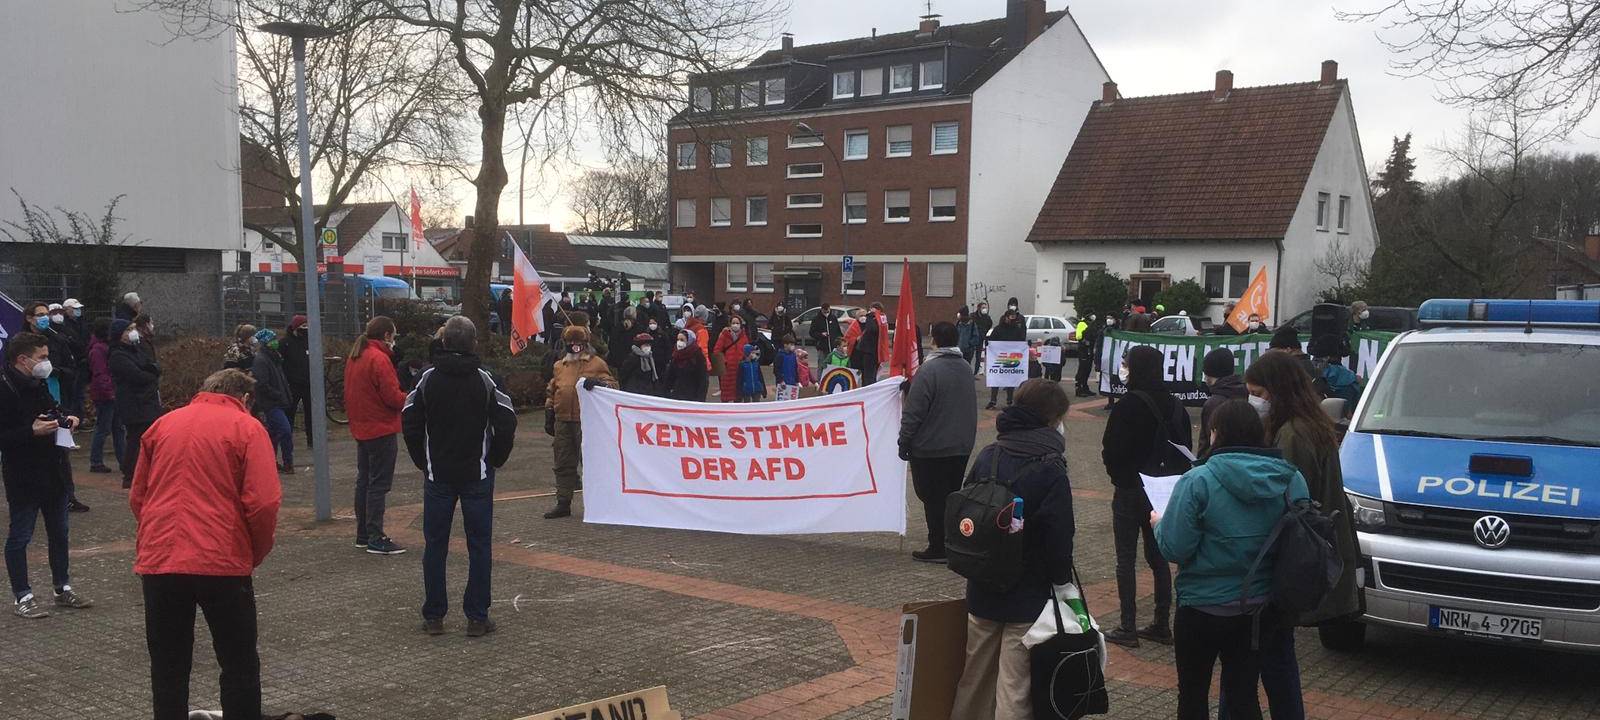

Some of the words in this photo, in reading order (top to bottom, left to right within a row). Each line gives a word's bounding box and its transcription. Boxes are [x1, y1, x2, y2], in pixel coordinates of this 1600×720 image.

[999, 367, 1024, 375] borders
[1187, 389, 1198, 400] und
[635, 422, 722, 448] KEINE
[728, 421, 848, 449] STIMME
[680, 456, 737, 481] DER
[747, 457, 806, 481] AFD
[1417, 476, 1581, 506] POLIZEI
[1440, 610, 1471, 628] NRW
[1481, 616, 1540, 636] 4-9705
